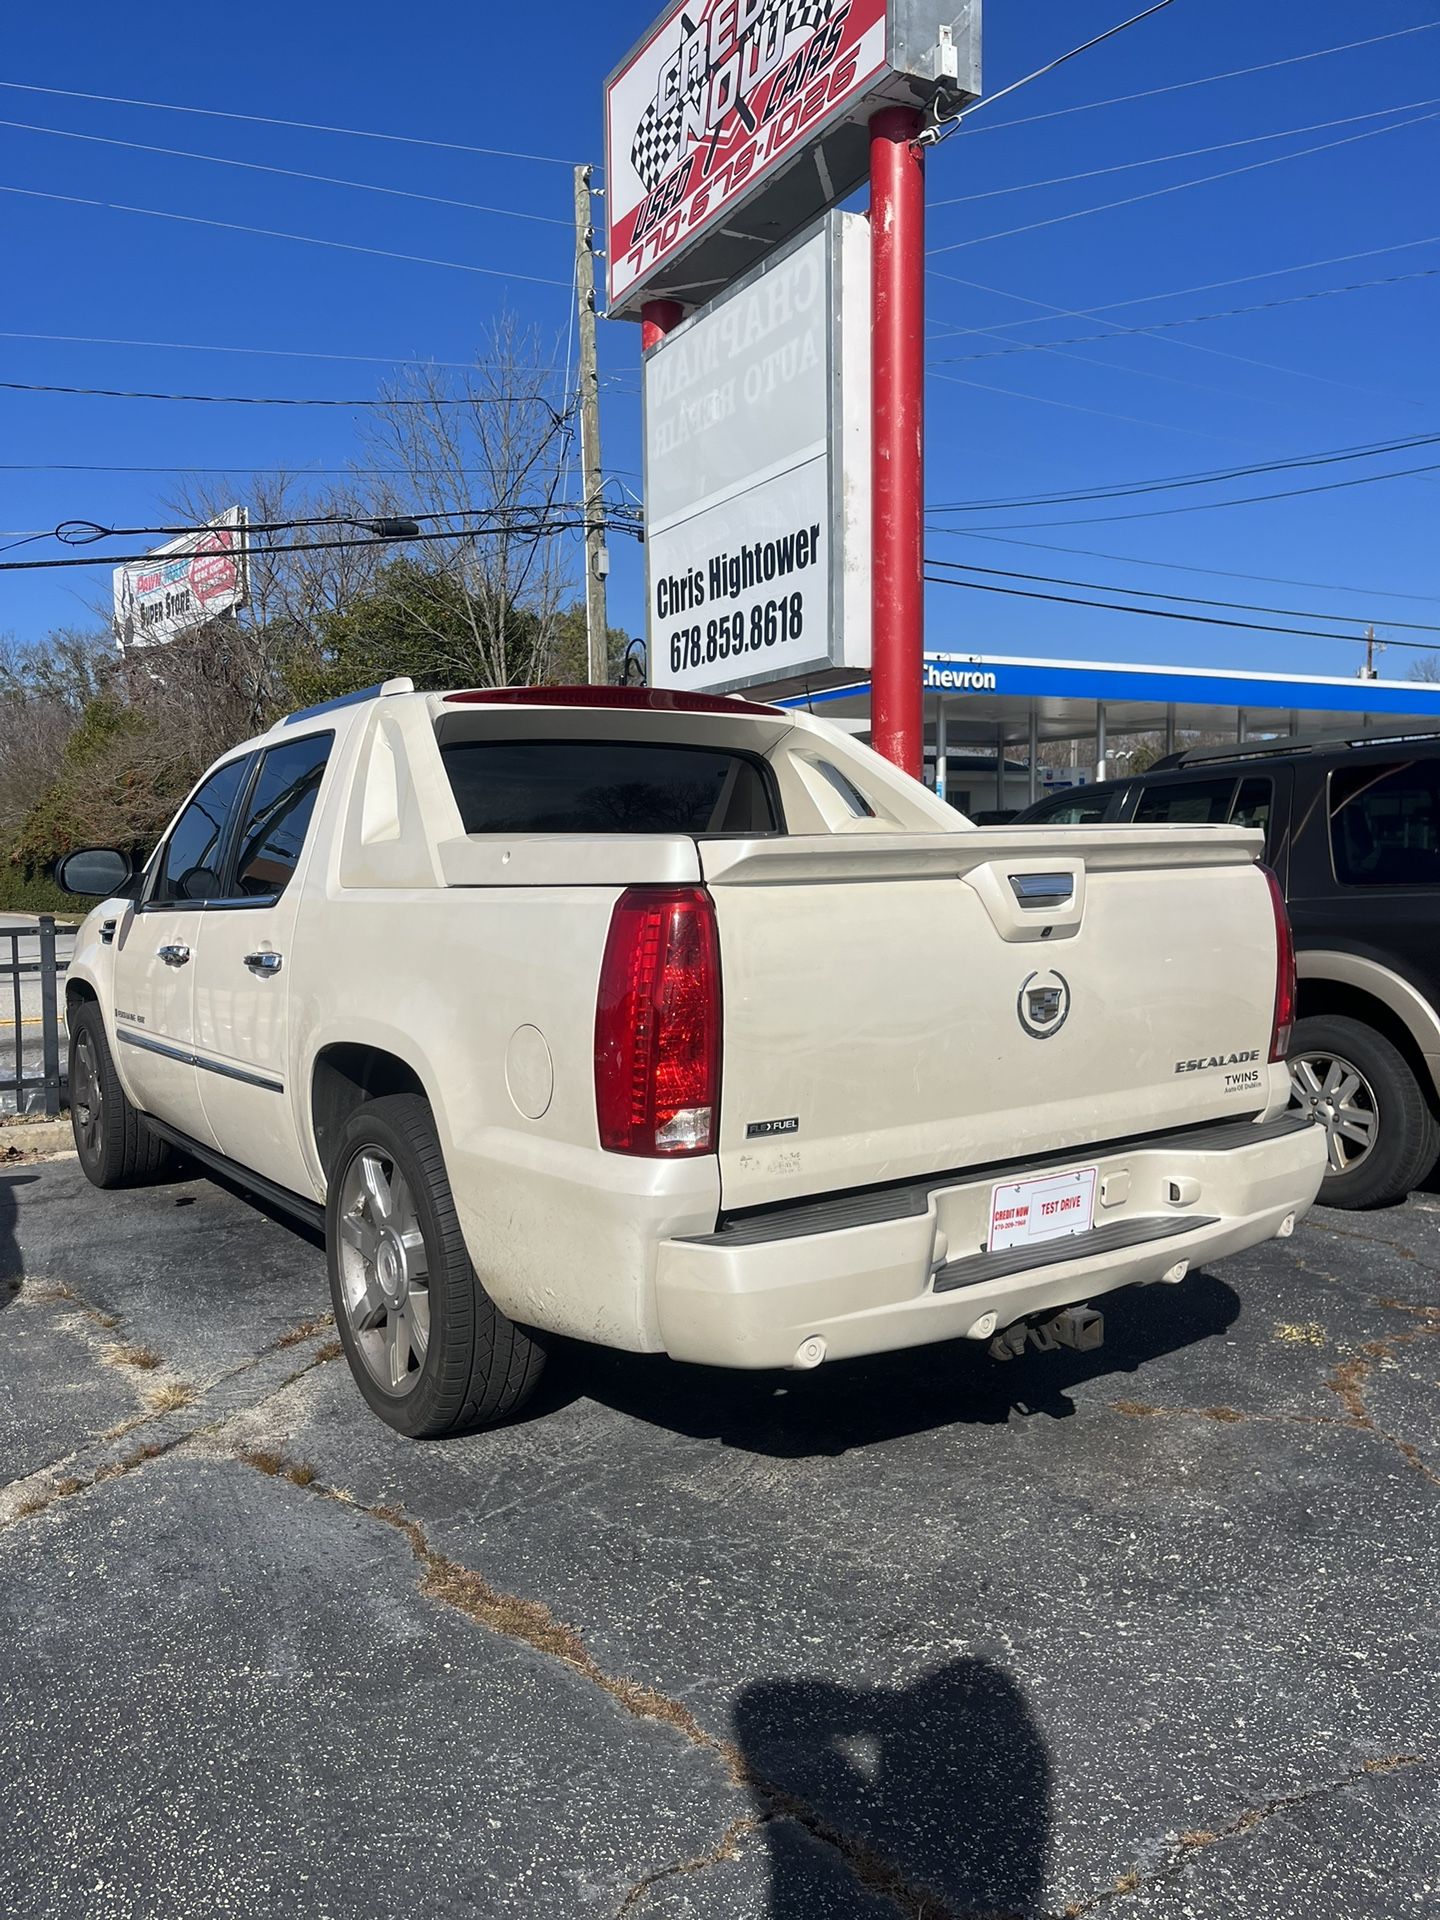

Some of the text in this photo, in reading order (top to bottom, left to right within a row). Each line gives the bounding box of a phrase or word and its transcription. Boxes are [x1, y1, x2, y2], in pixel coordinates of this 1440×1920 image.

[677, 1, 788, 162] NOW
[631, 4, 851, 246] USED CARS
[656, 566, 705, 620] Chris
[708, 522, 820, 601] Hightower
[669, 591, 803, 673] 678.859.8618
[1175, 1050, 1260, 1073] ESCALADE
[1225, 1071, 1259, 1085] TWINS
[773, 1120, 797, 1130] FUEL
[995, 1206, 1029, 1221] CREDIT NOW
[1042, 1195, 1081, 1215] TEST DRIVE
